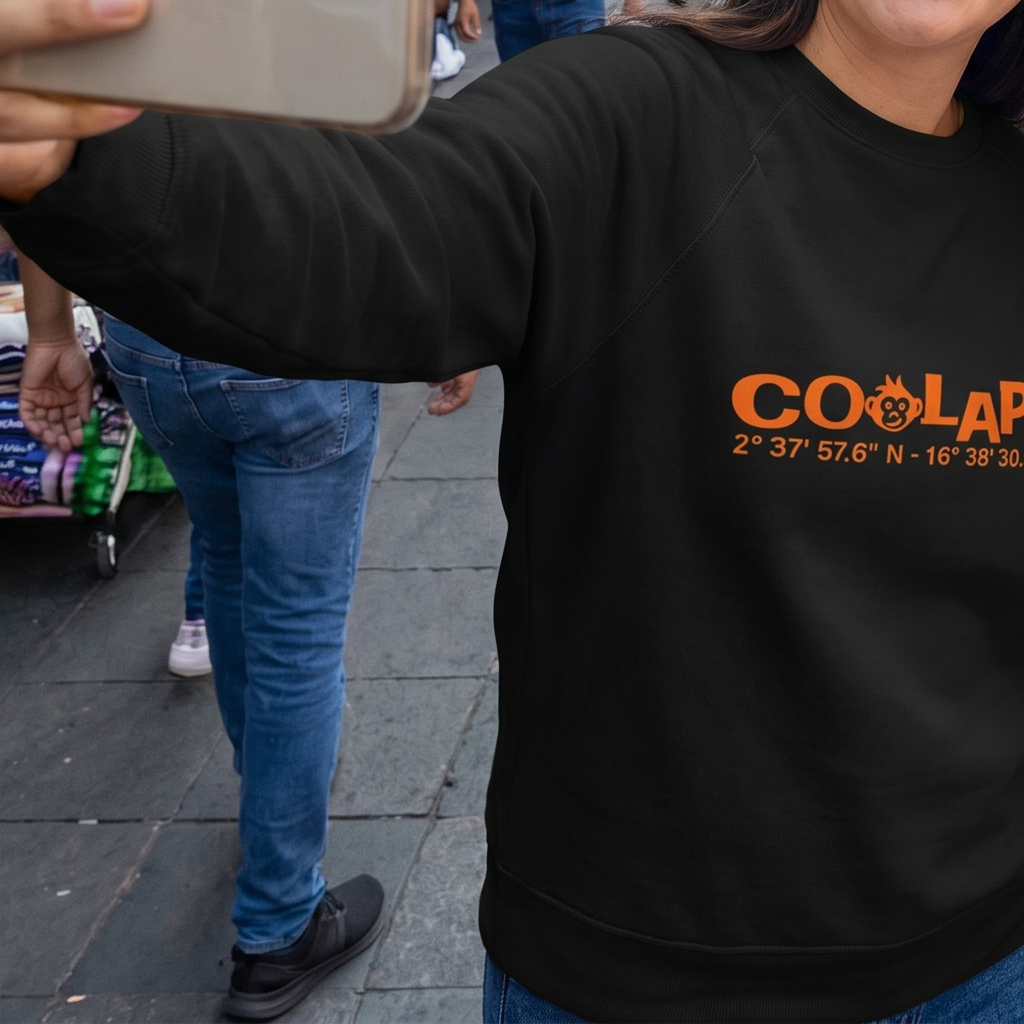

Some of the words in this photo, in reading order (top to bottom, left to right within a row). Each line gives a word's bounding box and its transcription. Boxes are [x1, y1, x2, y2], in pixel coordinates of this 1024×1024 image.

[732, 433, 763, 456] 2°
[769, 435, 810, 459] 37'
[817, 439, 879, 464] 57.6"
[885, 443, 904, 465] N
[926, 445, 960, 466] 16°
[965, 446, 995, 467] 38'
